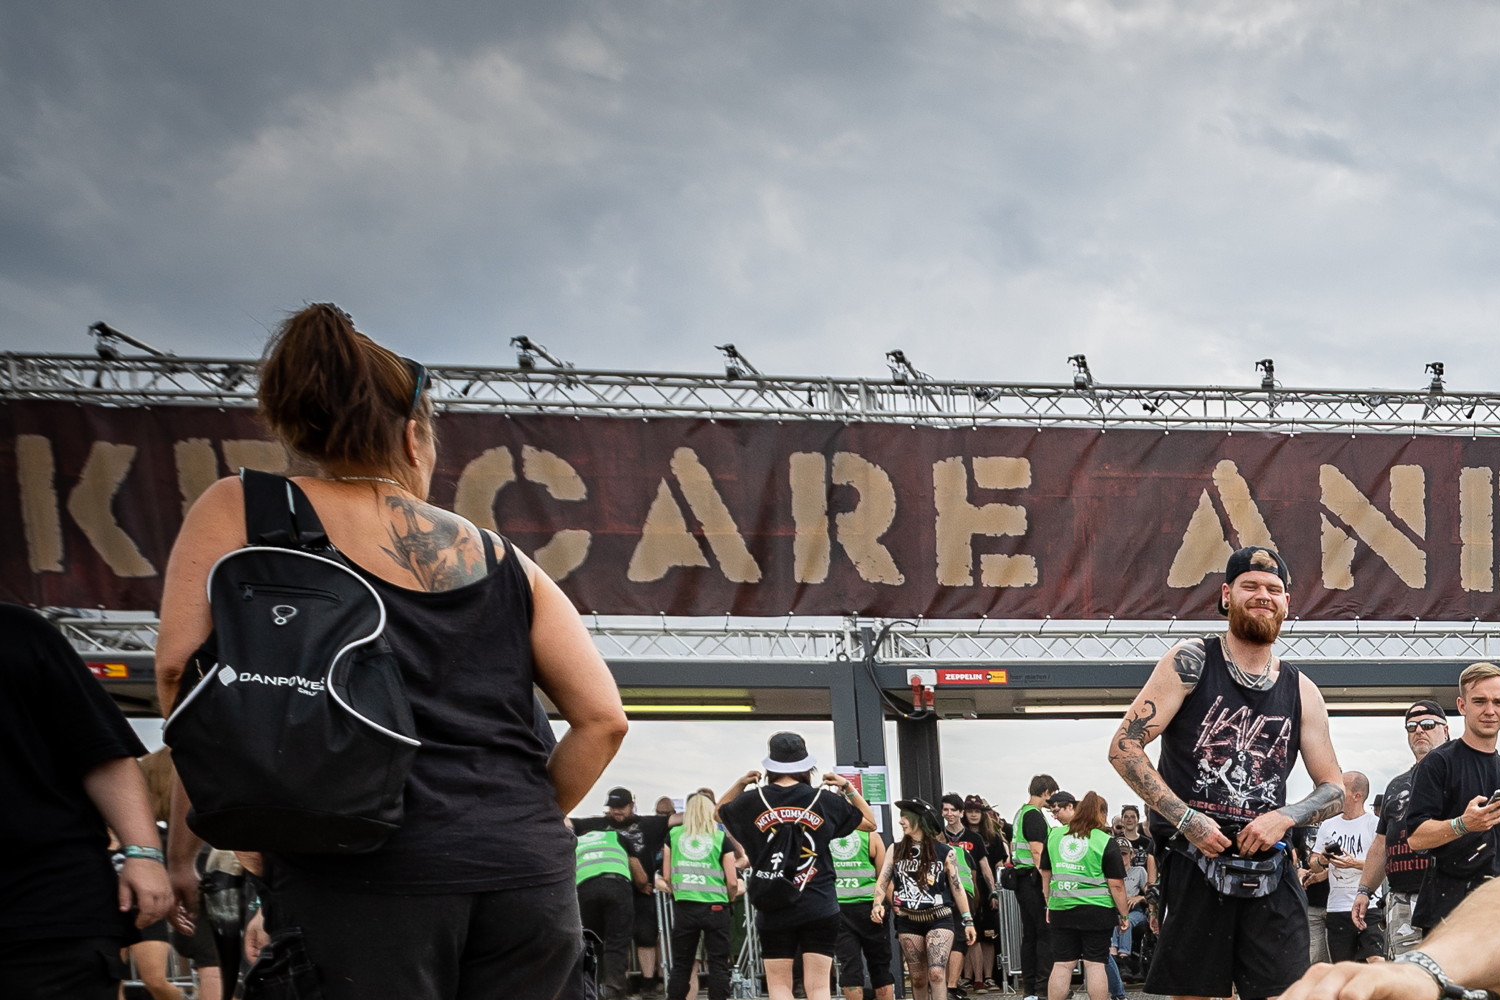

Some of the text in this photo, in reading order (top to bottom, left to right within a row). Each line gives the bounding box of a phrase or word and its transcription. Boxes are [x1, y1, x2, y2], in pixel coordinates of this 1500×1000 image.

[454, 444, 1039, 587] CARE
[1193, 695, 1291, 760] SLAYER
[682, 873, 706, 885] 223
[836, 877, 860, 888] 273
[1058, 880, 1078, 890] 662
